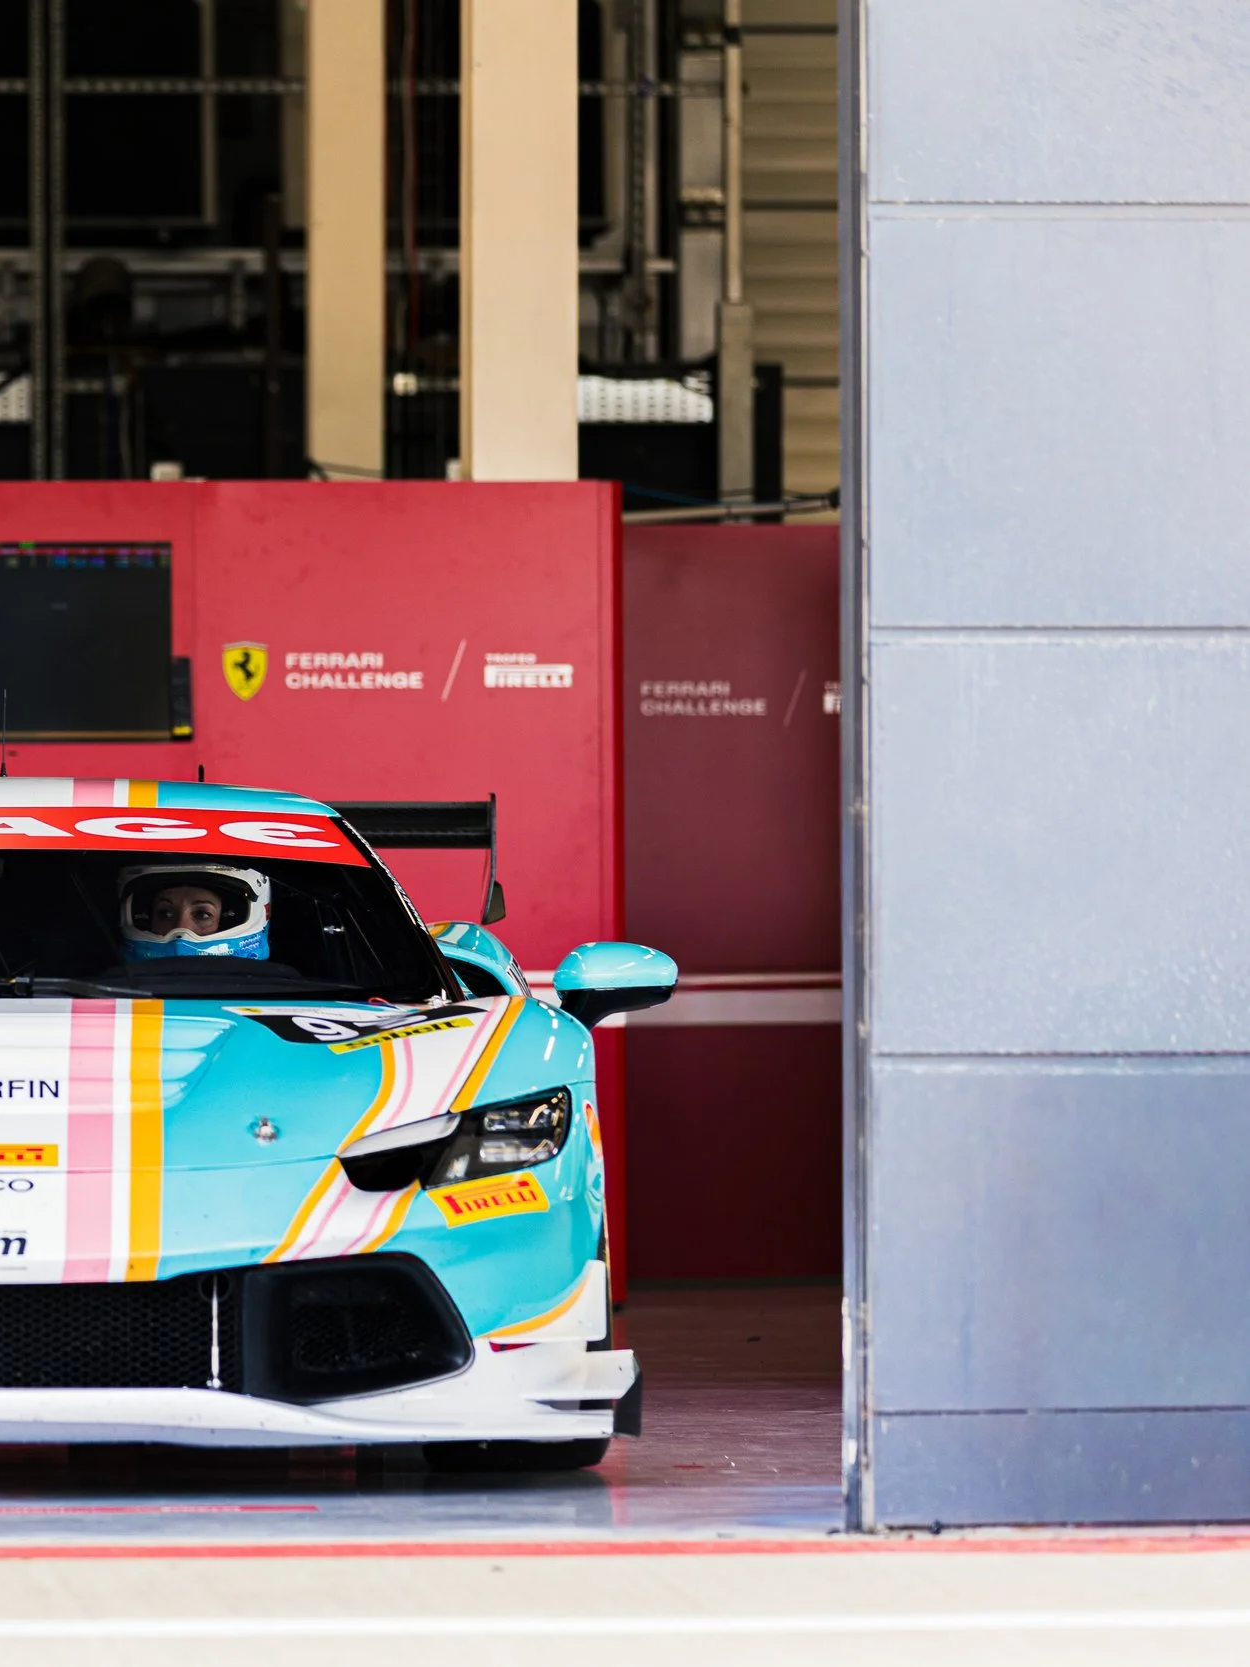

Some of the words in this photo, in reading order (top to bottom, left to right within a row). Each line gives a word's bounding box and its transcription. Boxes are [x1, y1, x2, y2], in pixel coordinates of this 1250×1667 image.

[285, 652, 383, 668] FERRARI
[285, 672, 423, 689] CHALLENGE
[484, 664, 574, 688] PIRELLI
[640, 680, 730, 697] FERRARI
[640, 698, 766, 716] CHALLENGE
[443, 1180, 538, 1214] PIRELLI
